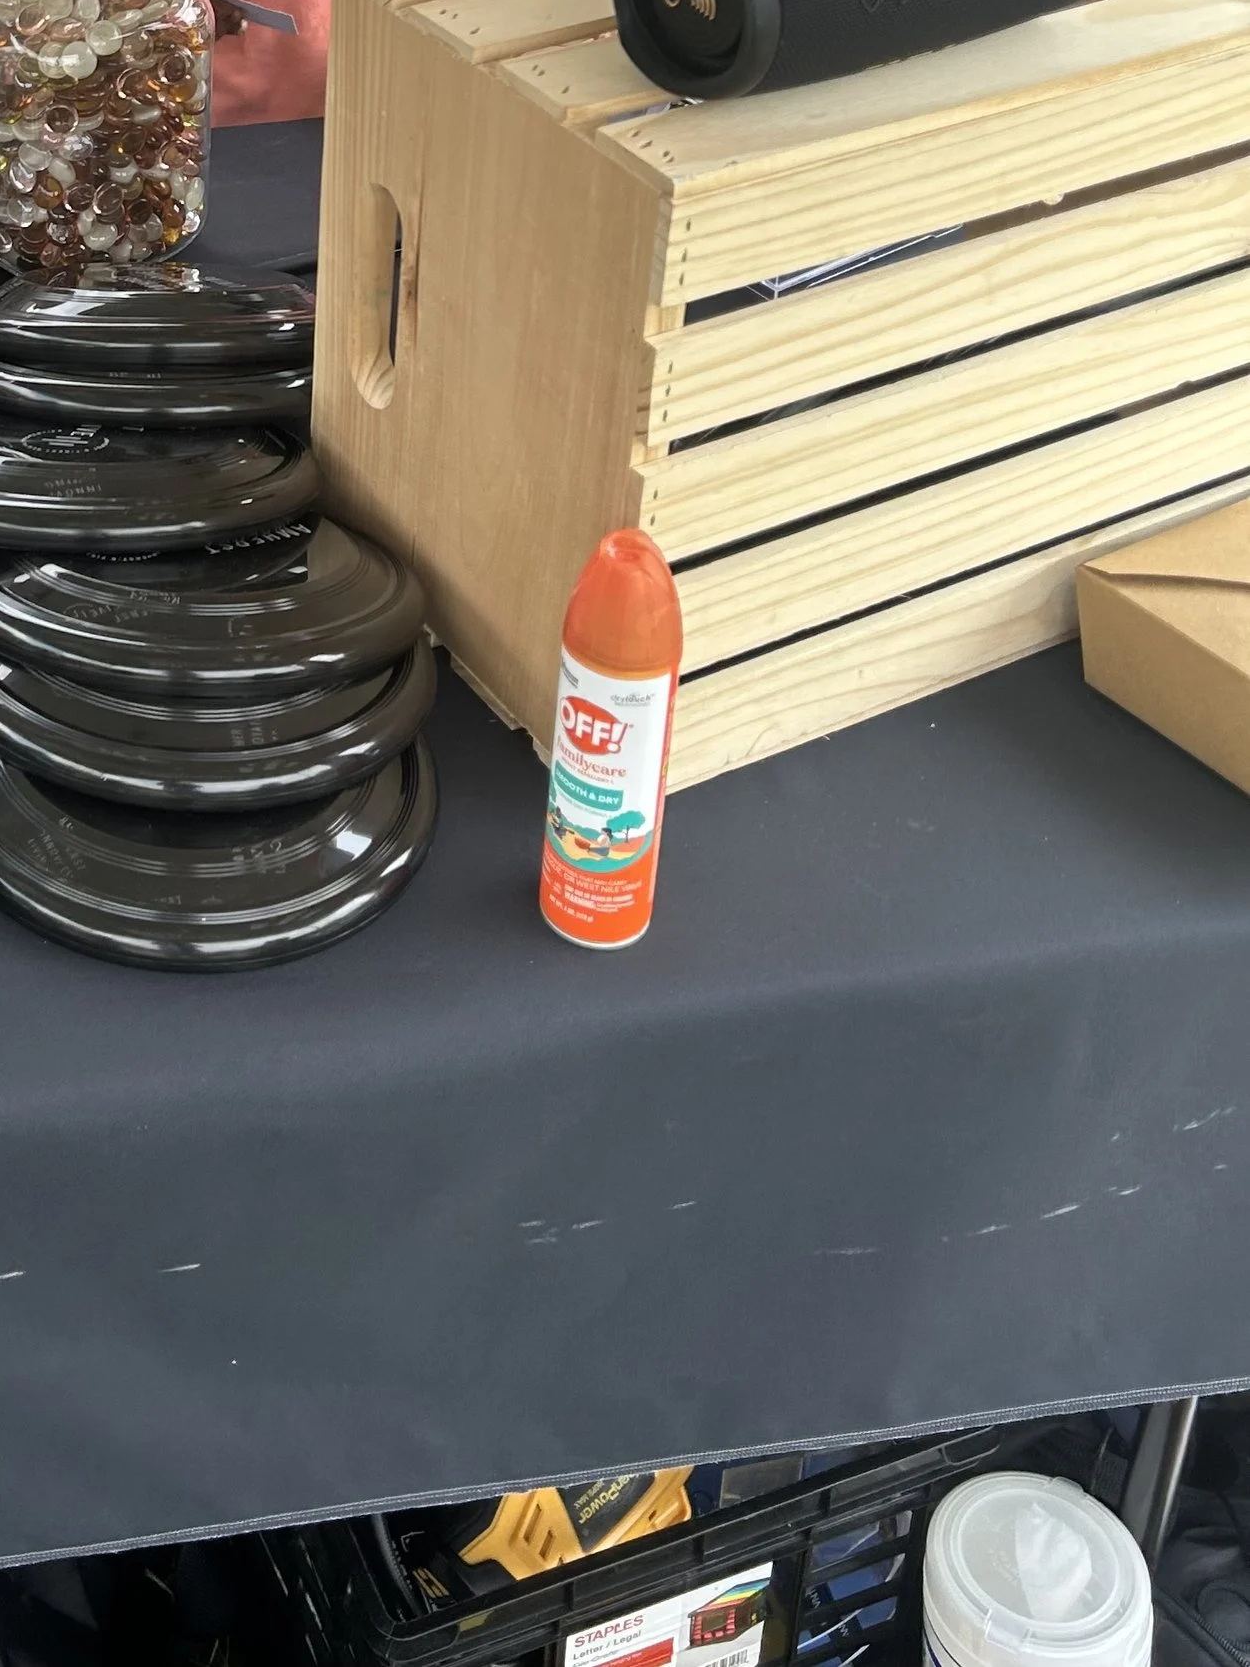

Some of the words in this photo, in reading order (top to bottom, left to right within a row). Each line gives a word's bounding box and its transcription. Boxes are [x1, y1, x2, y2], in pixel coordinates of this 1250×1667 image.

[560, 697, 629, 754] OFF!
[557, 735, 627, 777] familycare
[597, 795, 620, 805] DRY
[573, 1644, 604, 1660] Letter
[613, 1630, 642, 1646] Legal
[574, 1614, 644, 1648] STAPLES
